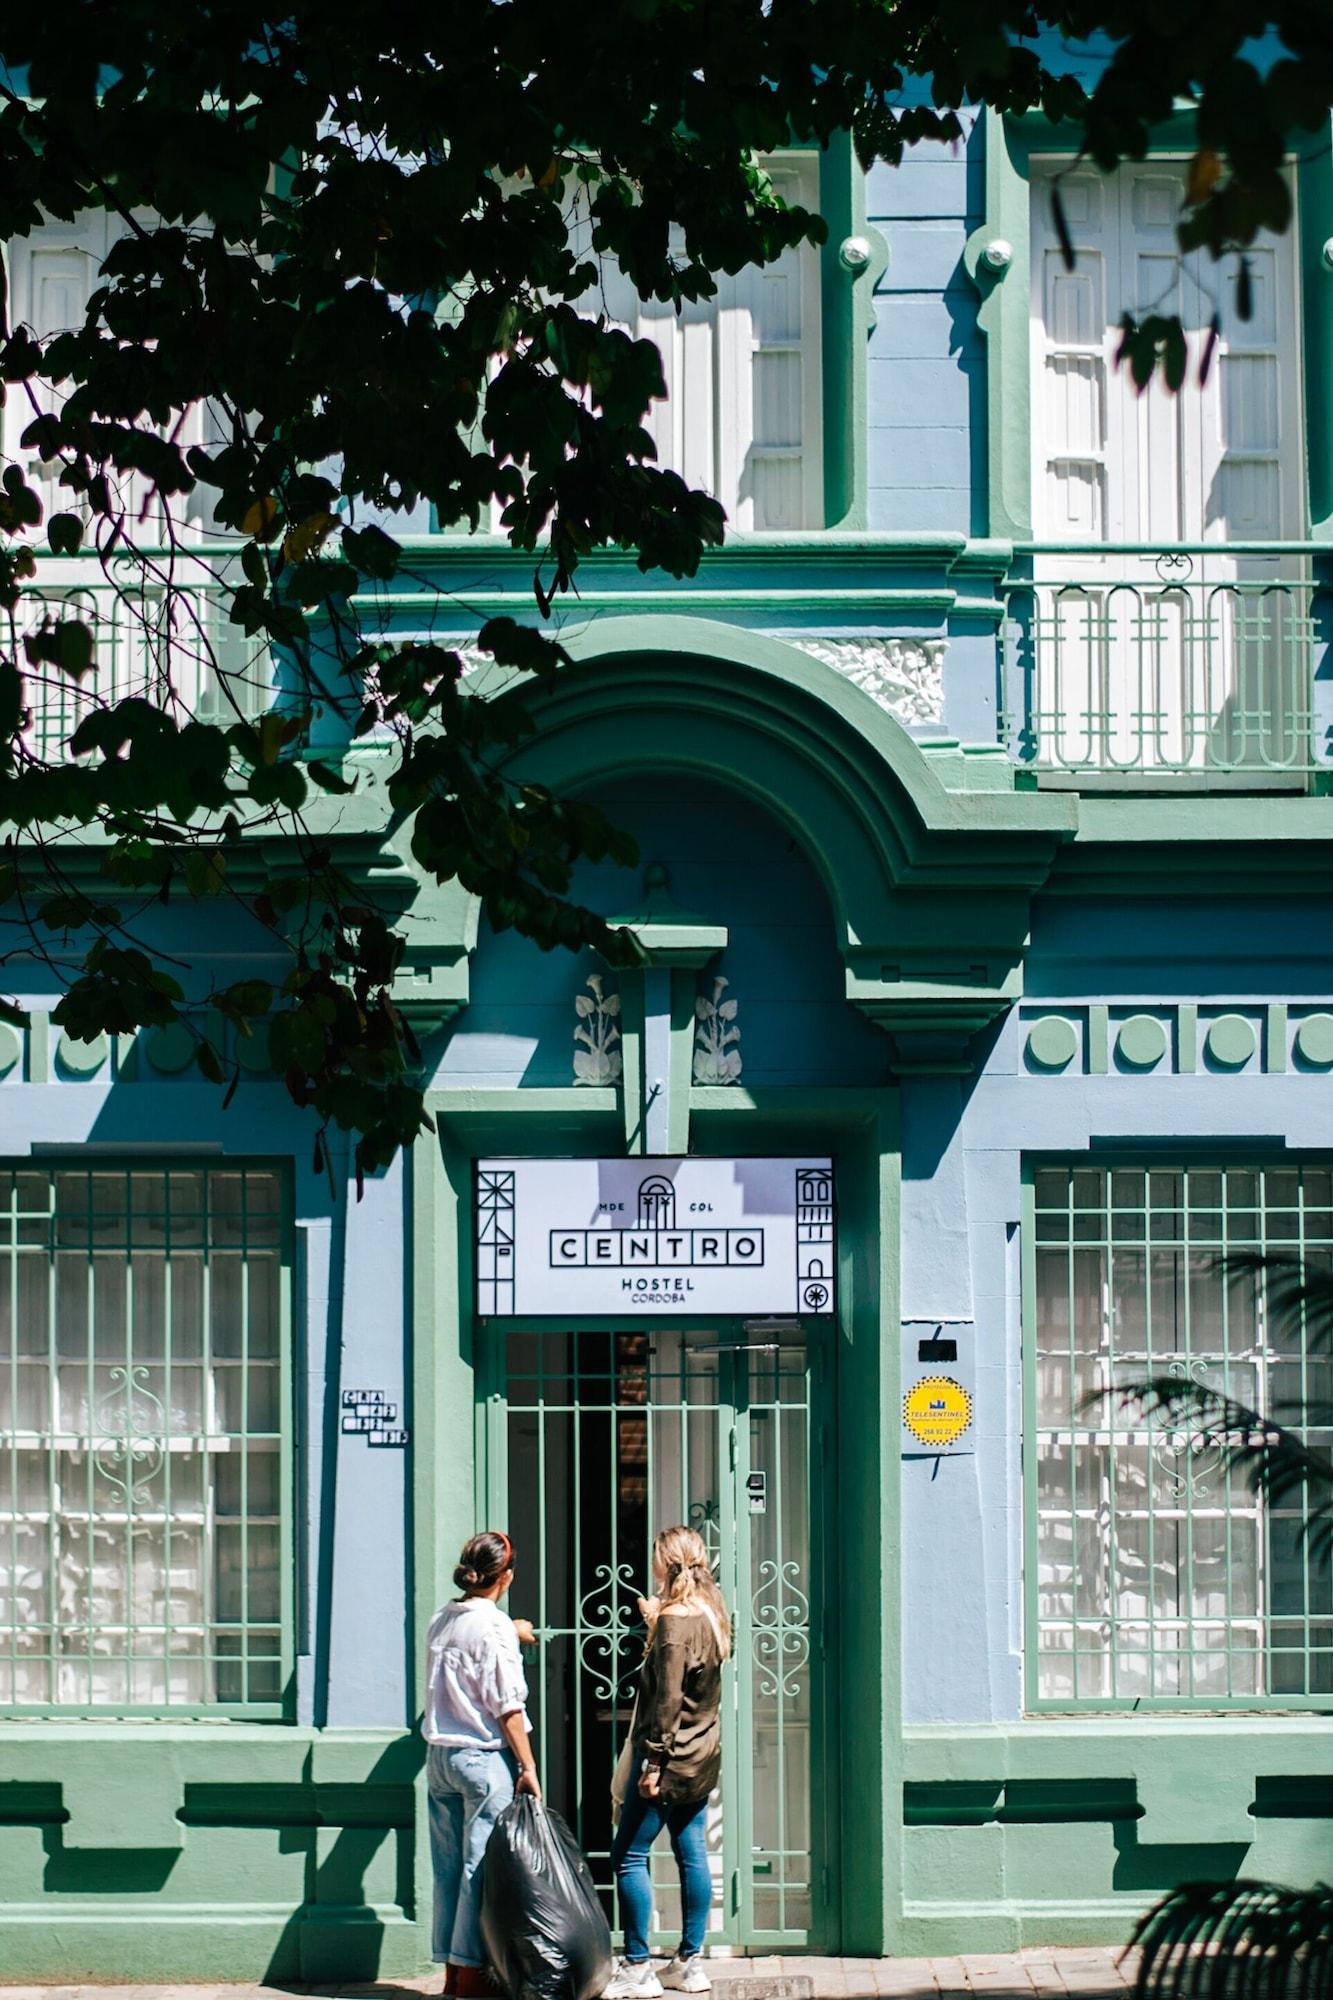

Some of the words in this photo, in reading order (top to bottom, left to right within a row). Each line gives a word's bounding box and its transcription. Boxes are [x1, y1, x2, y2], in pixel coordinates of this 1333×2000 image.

[599, 1202, 625, 1212] MDE
[689, 1202, 714, 1213] COL
[560, 1237, 756, 1260] CENTRO
[621, 1278, 695, 1291] HOSTEL
[631, 1292, 686, 1303] CORDOBA
